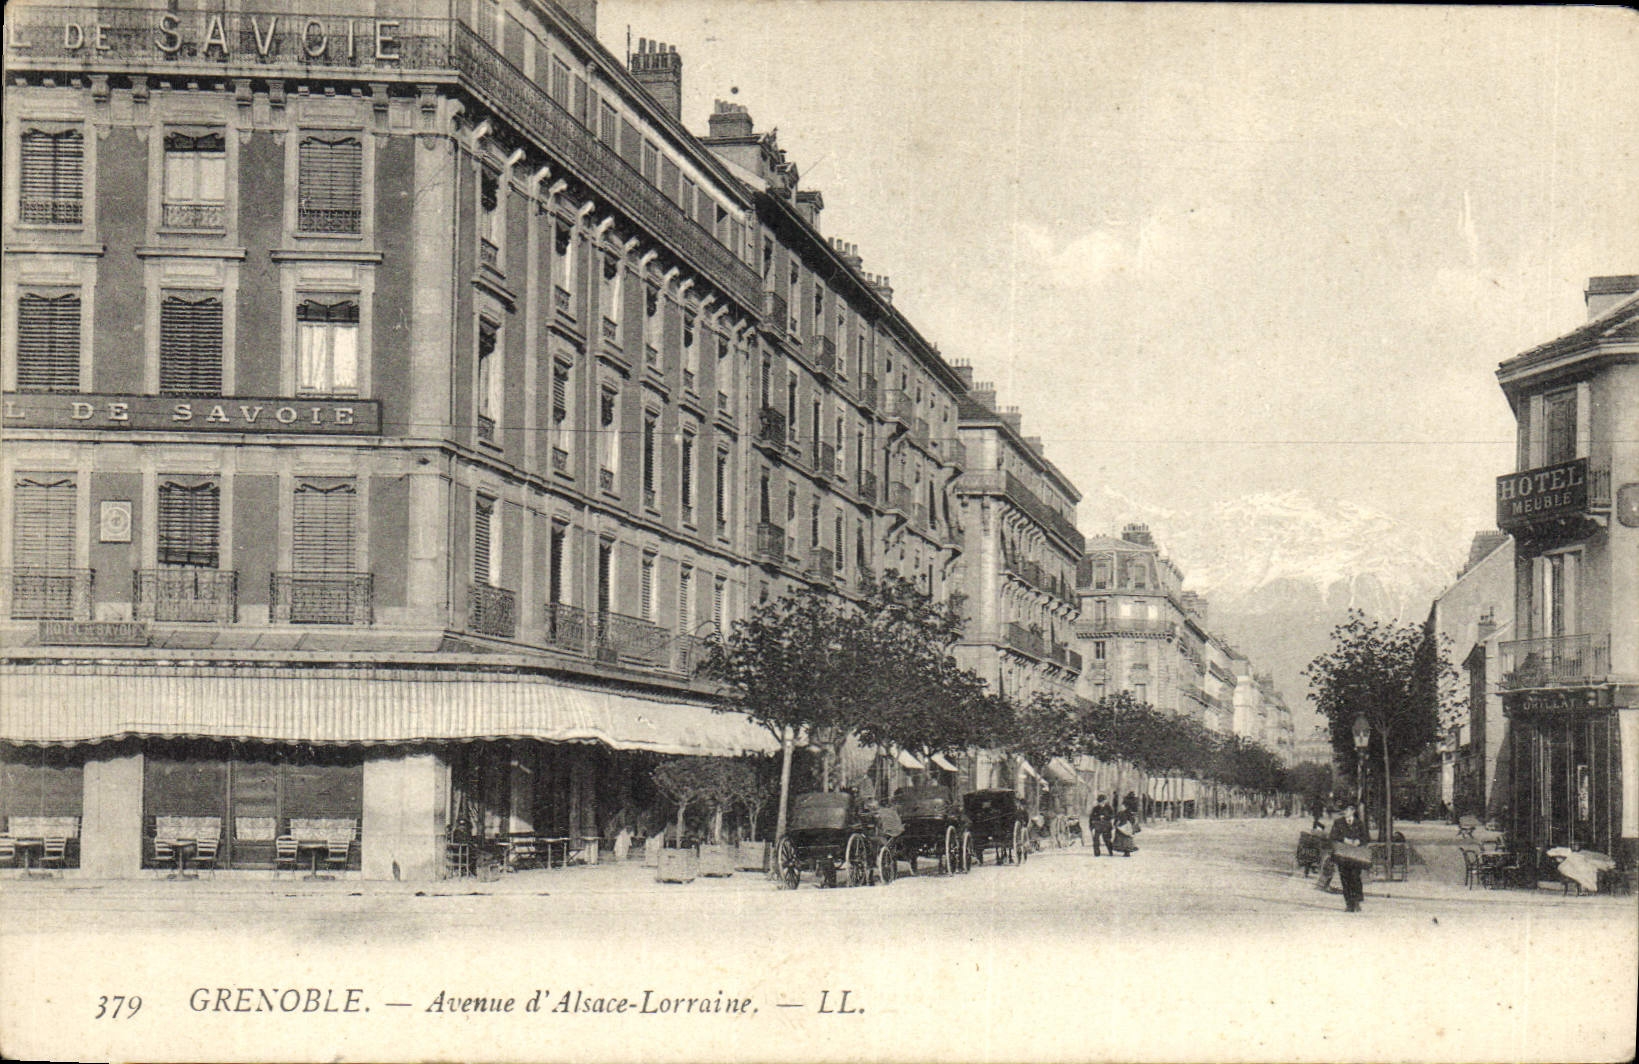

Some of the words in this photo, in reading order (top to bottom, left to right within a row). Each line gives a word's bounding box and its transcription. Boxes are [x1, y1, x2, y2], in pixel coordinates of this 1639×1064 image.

[62, 23, 111, 50] DE
[154, 12, 401, 61] SAVOIE
[71, 402, 129, 421] DE
[172, 403, 354, 425] SAVOIE
[1500, 465, 1584, 500] HOTEL
